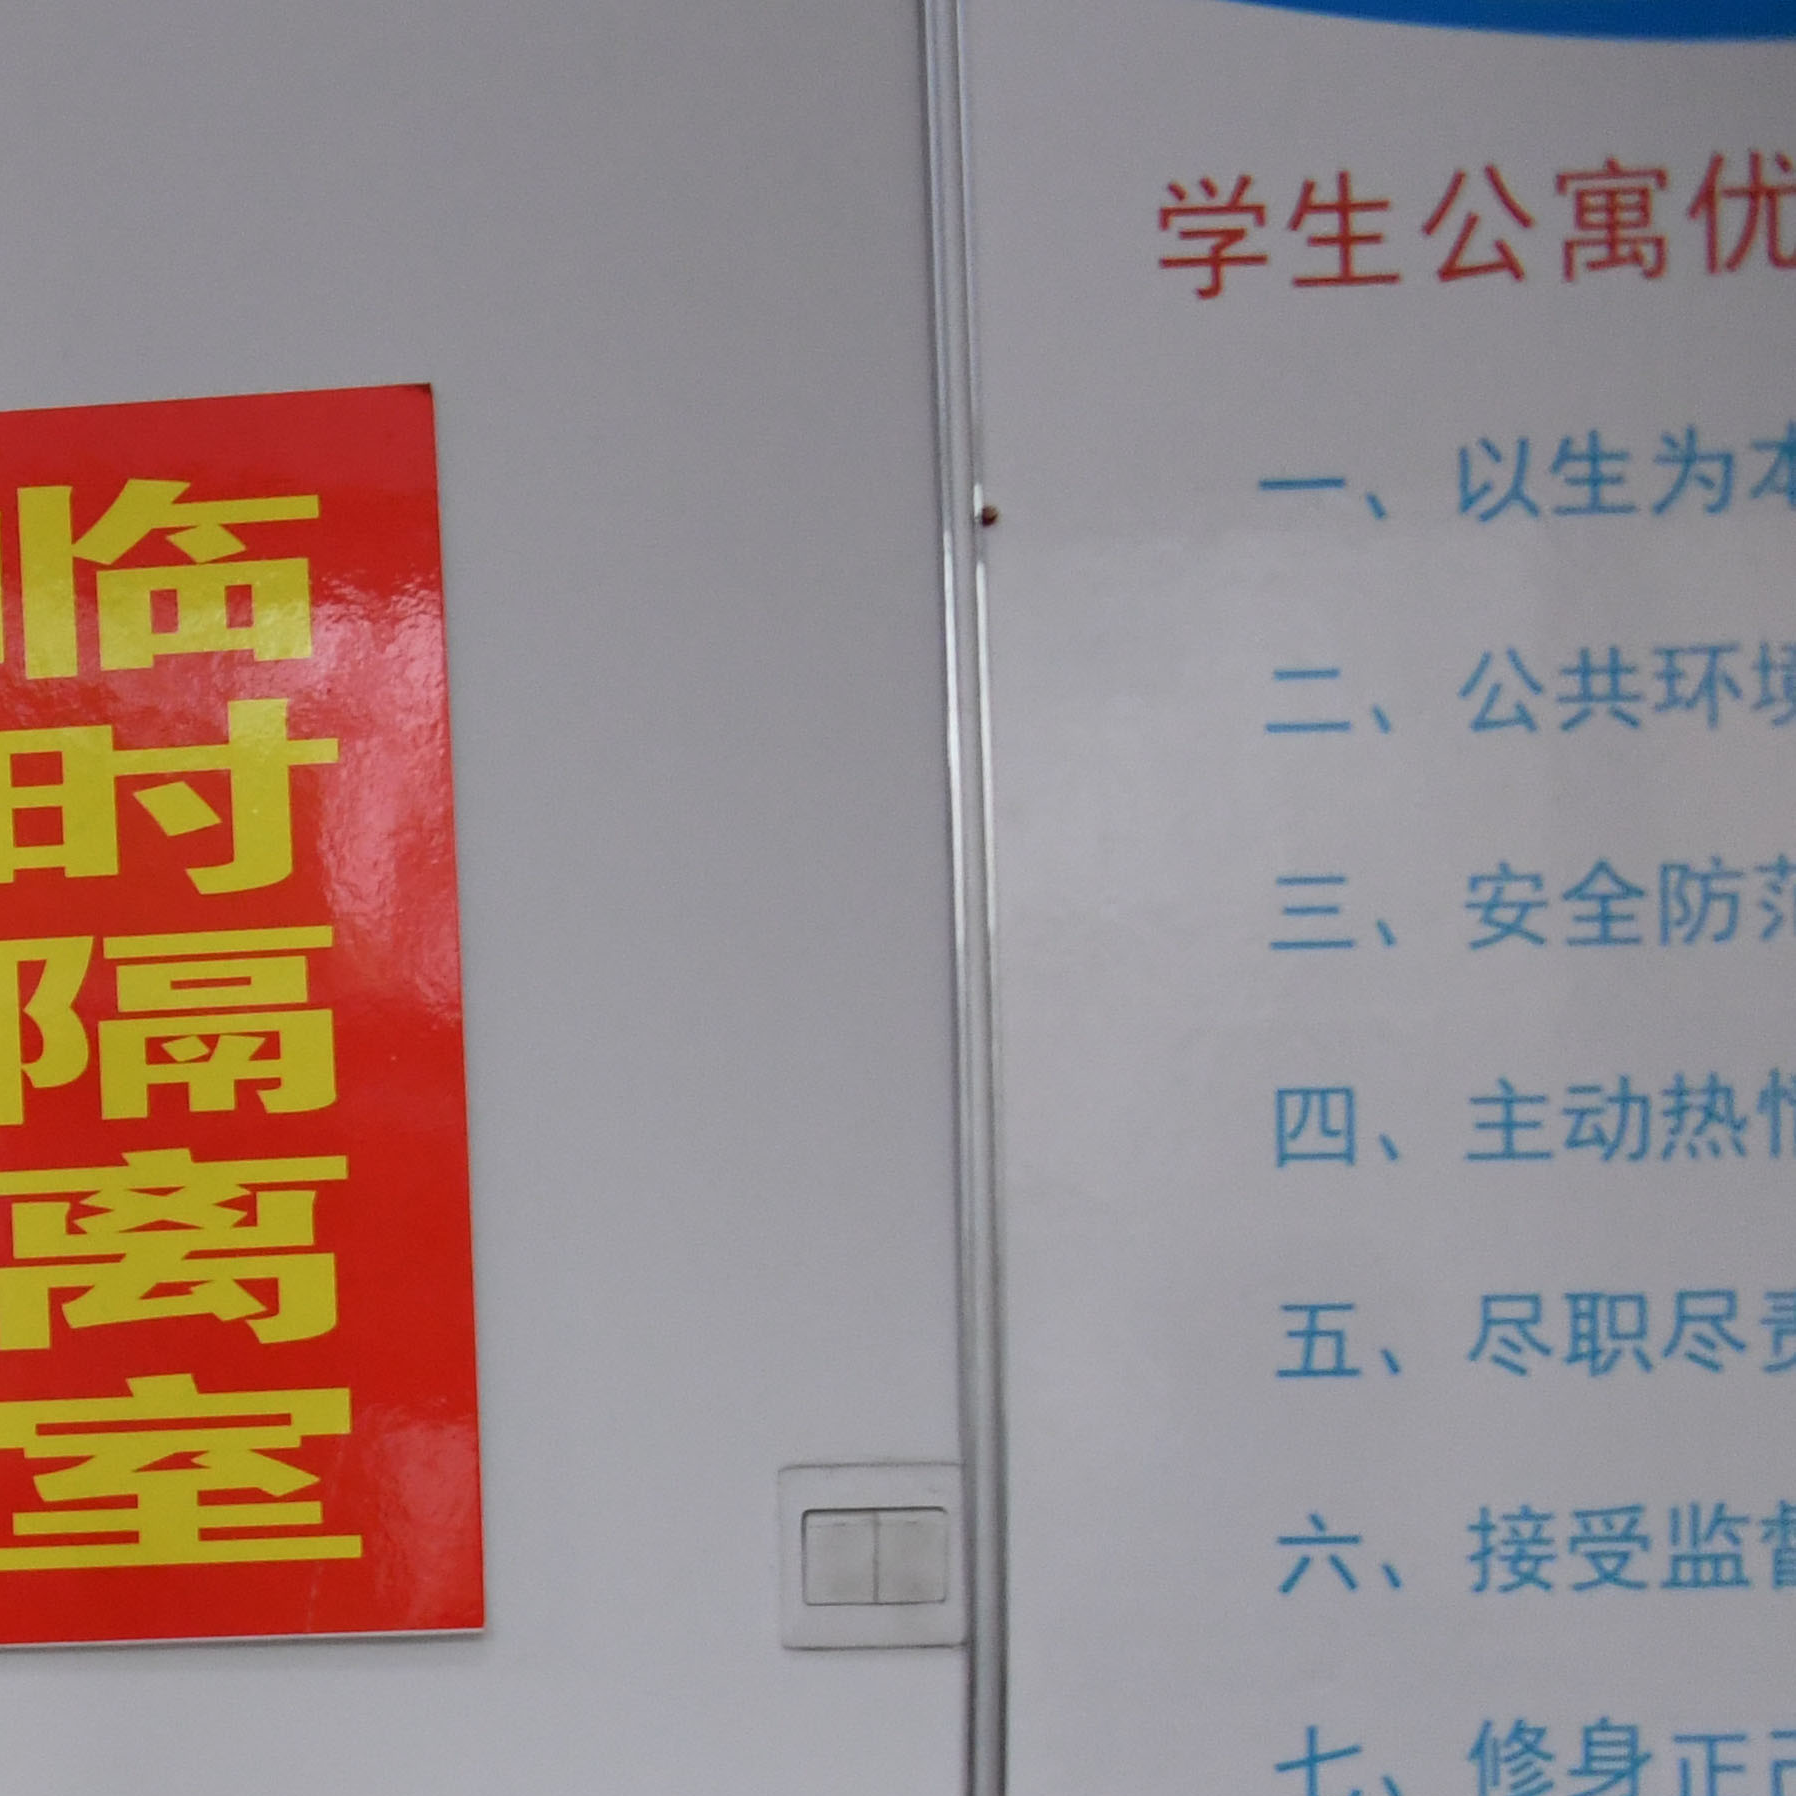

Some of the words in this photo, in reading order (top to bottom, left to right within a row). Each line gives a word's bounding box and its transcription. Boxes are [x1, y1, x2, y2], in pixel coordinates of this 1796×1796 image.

[1158, 151, 1796, 300] 学生公寓优
